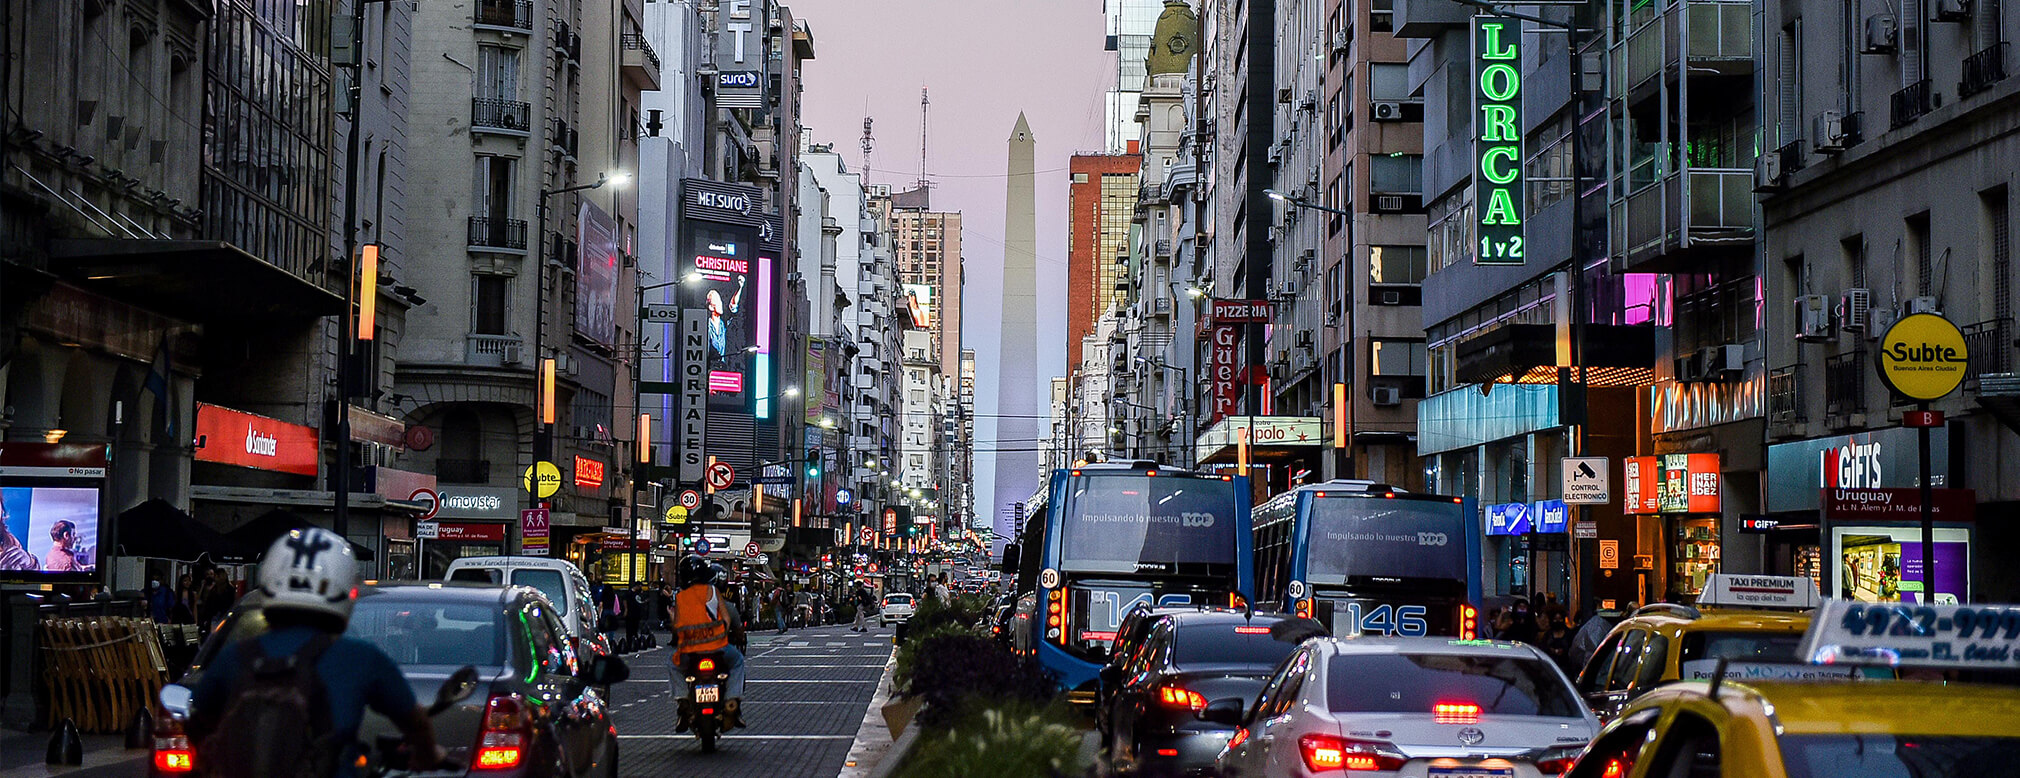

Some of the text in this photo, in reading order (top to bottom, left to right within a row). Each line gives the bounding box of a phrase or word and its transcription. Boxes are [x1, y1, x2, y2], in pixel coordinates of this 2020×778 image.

[720, 74, 746, 84] sura
[1480, 23, 1520, 225] LORCA
[698, 191, 743, 210] MET sura
[1481, 235, 1522, 258] 1 y 2
[695, 255, 748, 273] CHRISTIANE
[649, 310, 677, 318] LOS
[1215, 305, 1267, 318] PIZZERIA
[1893, 342, 1957, 362] Subte
[1215, 326, 1234, 413] Güerr
[686, 320, 703, 464] INMORTALES
[1923, 412, 1932, 424] B
[252, 430, 278, 457] Santander
[683, 495, 695, 504] 30
[1835, 489, 1893, 504] Uruguay
[1082, 513, 1134, 523] Impulsando
[1136, 513, 1144, 522] lo
[1147, 515, 1180, 523] nuestro
[1327, 531, 1375, 541] Impulsando
[1376, 531, 1384, 540] lo
[1385, 534, 1416, 542] nuestro
[1606, 549, 1612, 557] E
[1042, 572, 1055, 584] 60
[1729, 577, 1794, 588] TAXI PREMIUM
[1289, 583, 1302, 594] 60
[1348, 602, 1427, 637] 146
[1693, 670, 1716, 680] Pag
[1724, 670, 1741, 678] con
[1803, 671, 1815, 679] en
